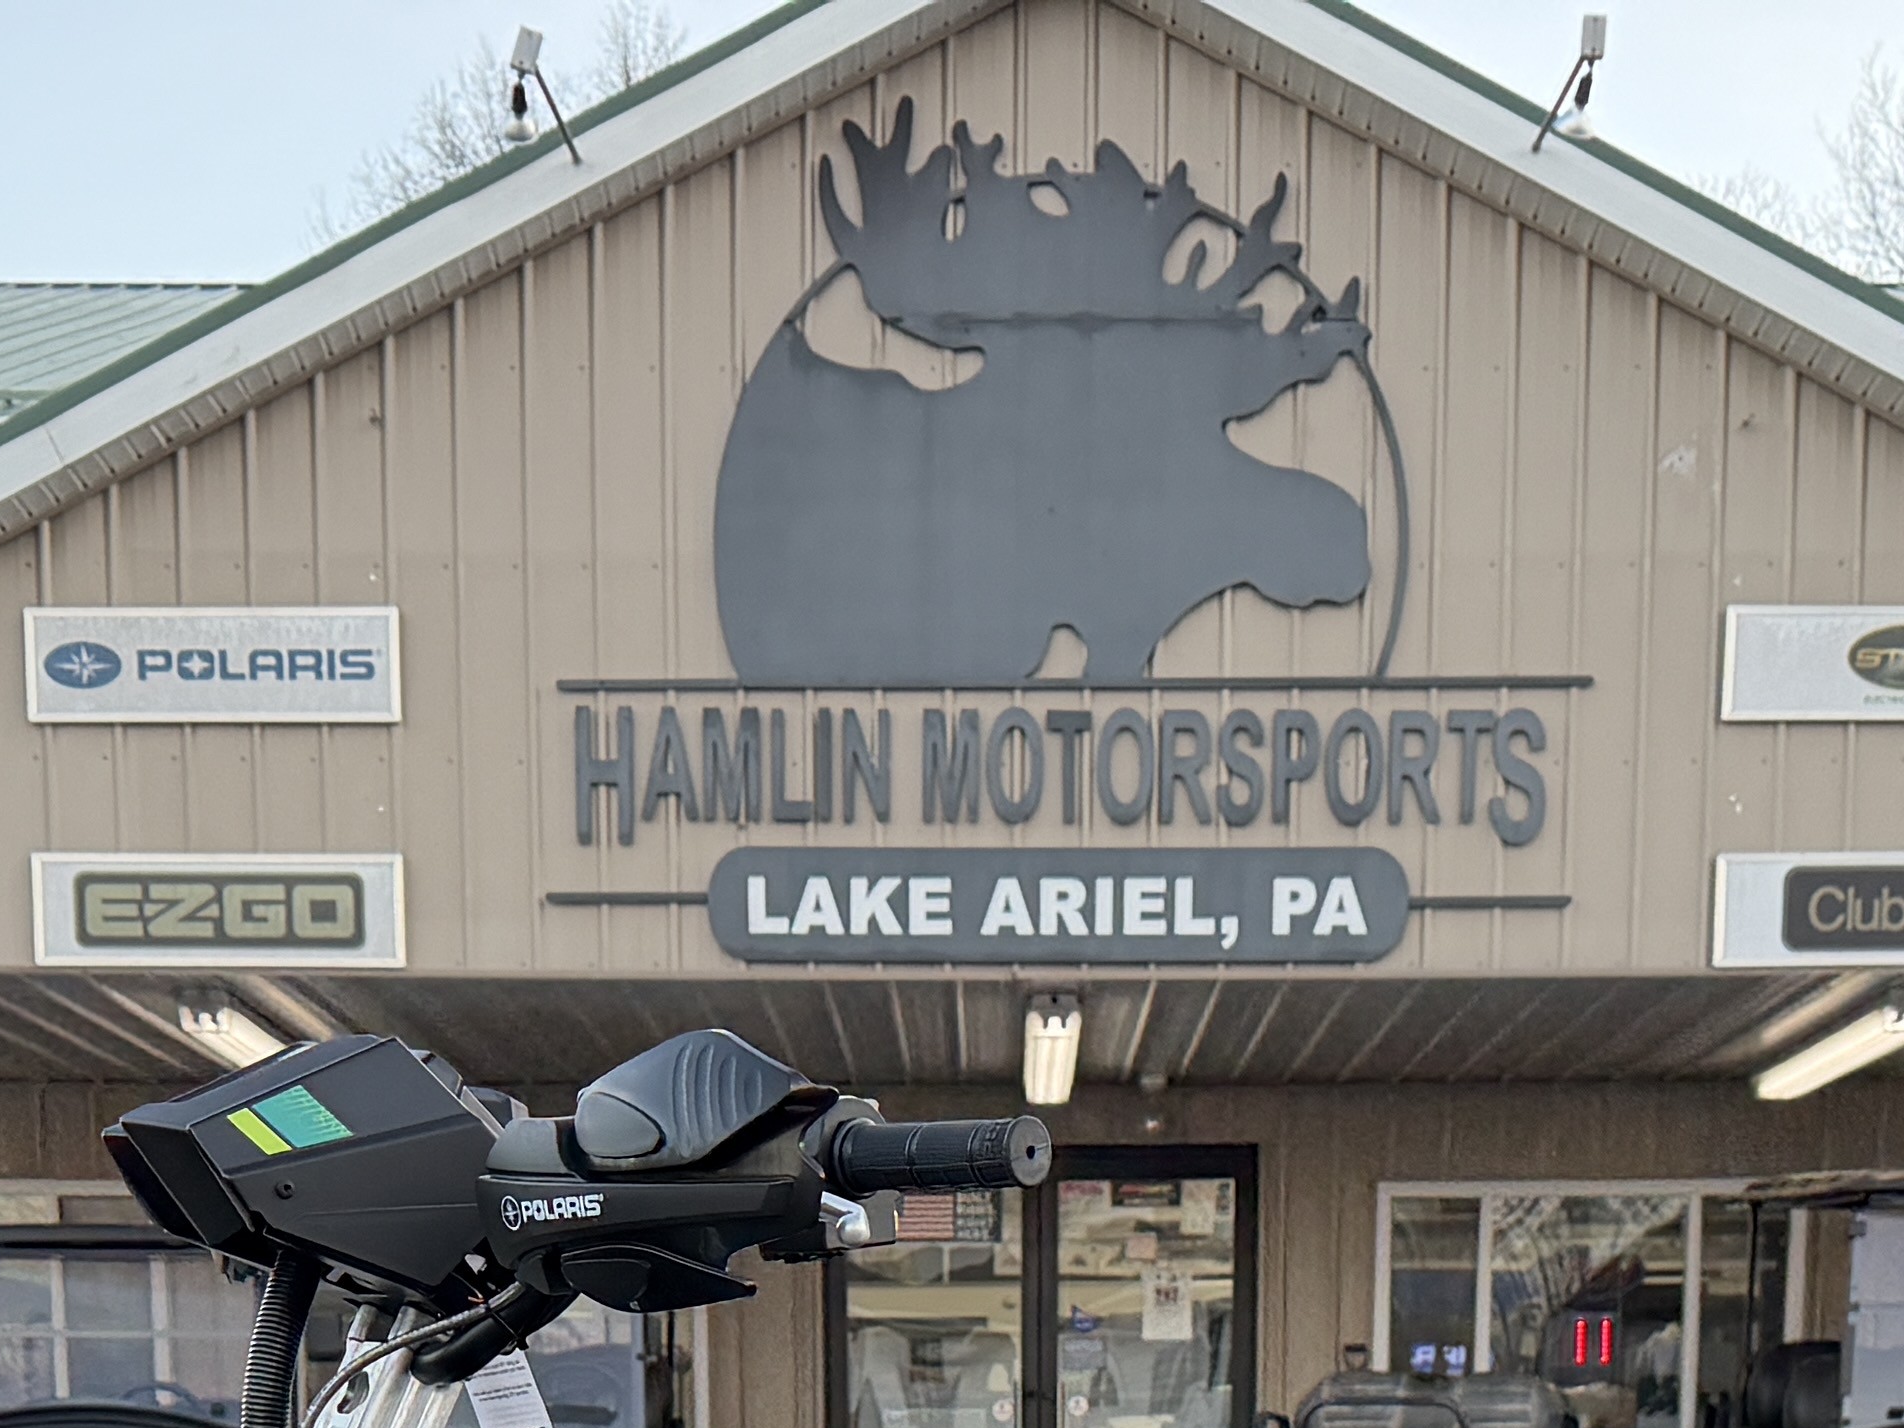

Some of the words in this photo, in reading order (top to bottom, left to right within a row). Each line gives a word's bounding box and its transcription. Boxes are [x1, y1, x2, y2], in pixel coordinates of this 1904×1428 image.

[136, 646, 376, 683] POLARIS
[573, 704, 892, 848] HAMLIN
[922, 705, 1548, 849] MOTORSPORTS
[84, 882, 359, 940] EZGO
[744, 874, 956, 938] LAKE
[980, 874, 1240, 953] ARIEL,
[1269, 875, 1370, 938] PA
[520, 1193, 599, 1224] POLARIS
